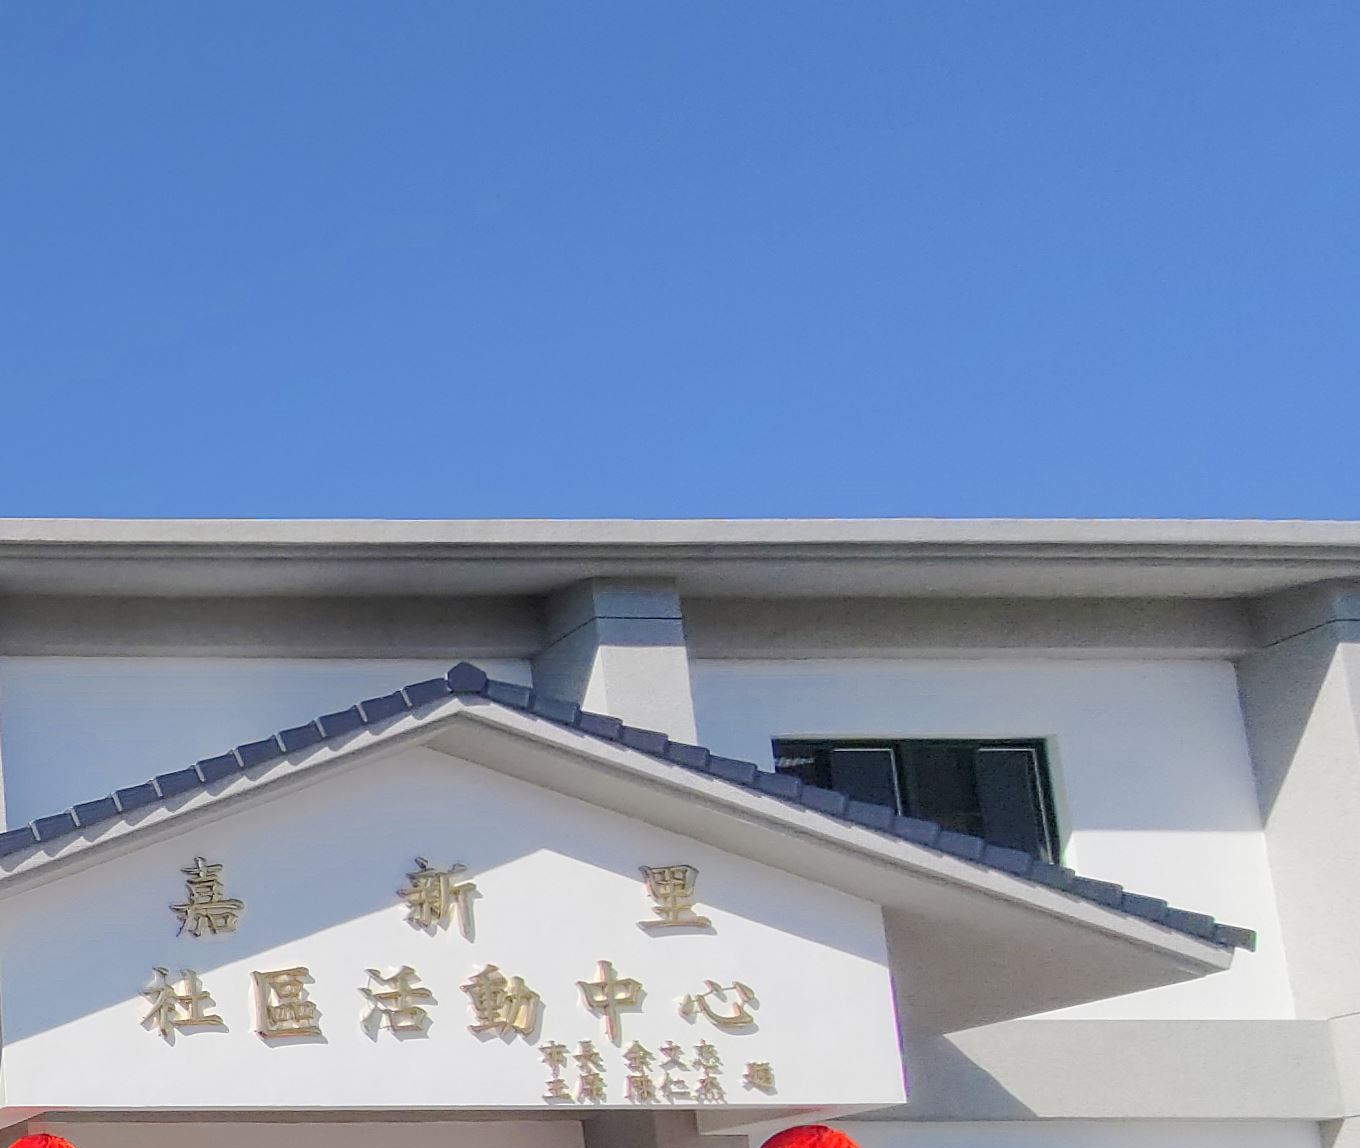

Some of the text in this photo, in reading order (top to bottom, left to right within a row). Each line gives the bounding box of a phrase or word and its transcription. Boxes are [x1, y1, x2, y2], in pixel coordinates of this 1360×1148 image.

[172, 856, 714, 940] 嘉新里
[141, 960, 760, 1043] 社區活動中心
